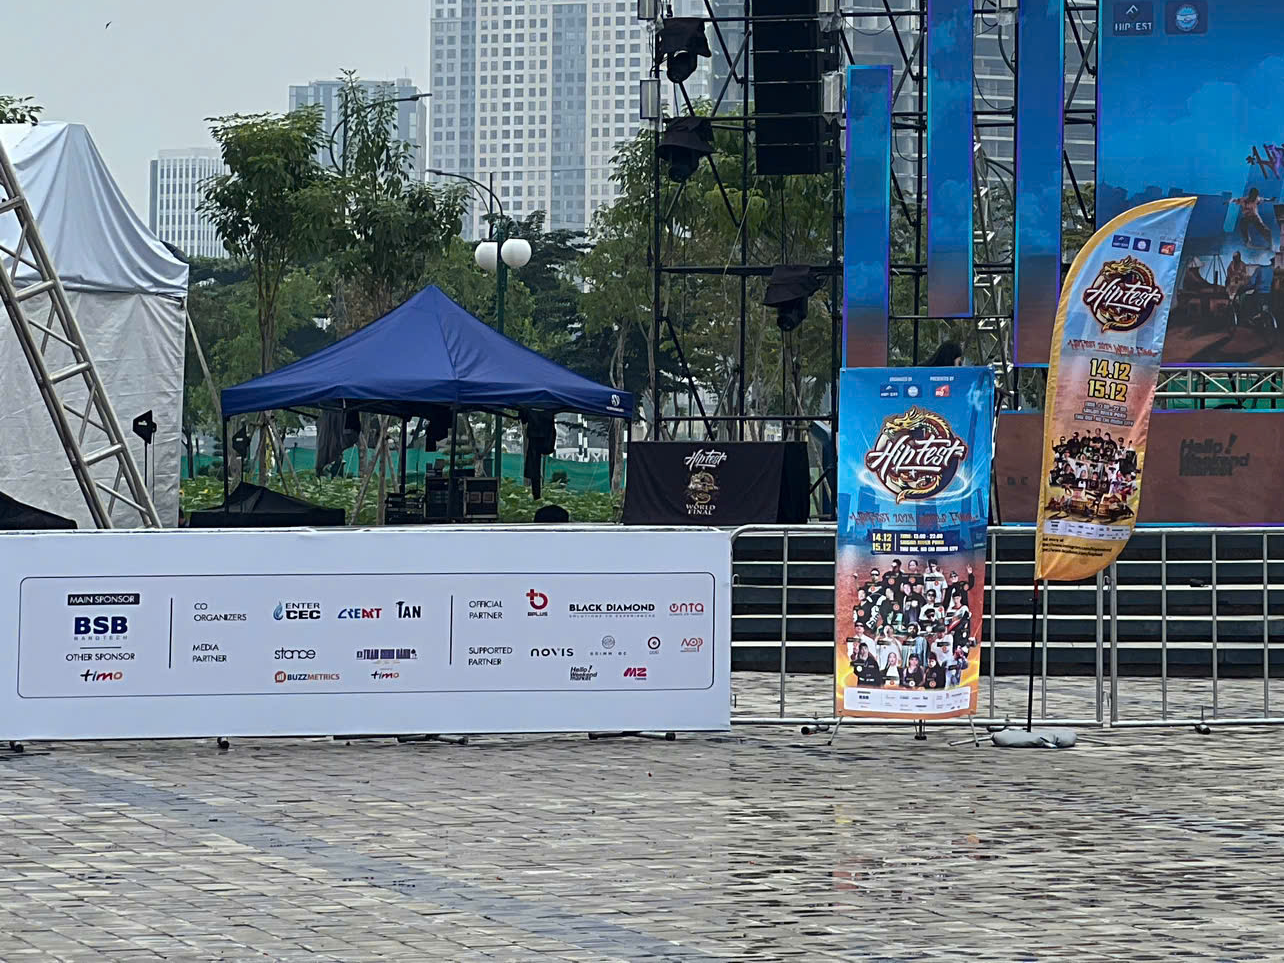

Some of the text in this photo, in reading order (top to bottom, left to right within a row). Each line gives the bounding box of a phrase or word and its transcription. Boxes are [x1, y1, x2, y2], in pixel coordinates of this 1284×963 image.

[1090, 358, 1131, 381] 14.12
[1088, 379, 1128, 402] 15.12
[872, 533, 892, 542] 14.12
[872, 542, 892, 551] 15.12
[69, 594, 136, 604] MAIN SPONSOR
[193, 602, 208, 610] CO
[468, 600, 503, 608] OFFICIAL
[606, 603, 655, 611] DIAMOND
[193, 613, 247, 622] ORGANIZERS
[285, 610, 321, 620] CEC
[468, 611, 503, 619] PARTNER
[73, 616, 128, 635] BSB
[192, 643, 219, 651] MEDIA
[468, 646, 513, 655] SUPPORTED
[65, 653, 135, 661] OTHER SPONSOR
[192, 654, 227, 662] PARTNER
[468, 658, 502, 666] PARTNER
[80, 669, 123, 681] timo
[287, 673, 340, 681] BUZZMETRICS
[371, 670, 399, 680] timo
